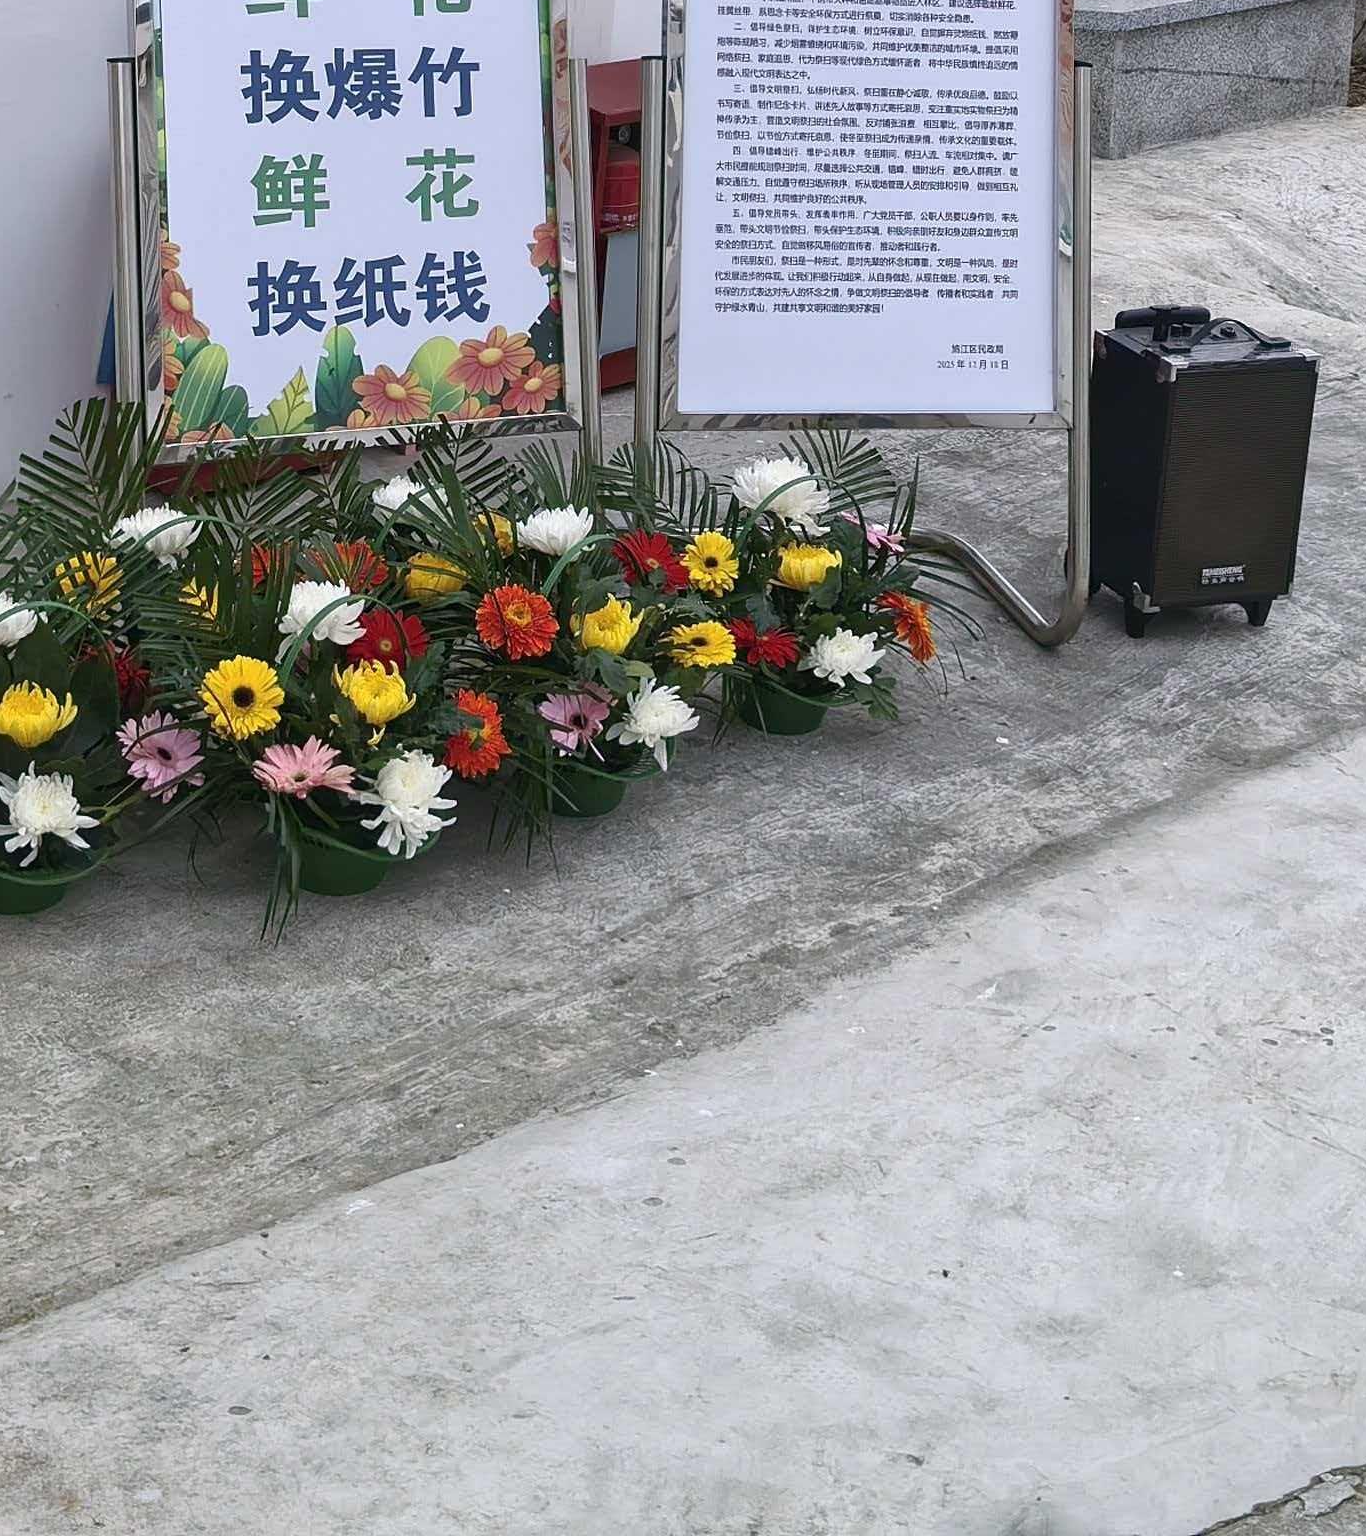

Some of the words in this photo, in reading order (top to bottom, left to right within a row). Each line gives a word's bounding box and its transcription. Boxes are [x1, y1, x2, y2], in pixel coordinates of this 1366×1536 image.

[240, 46, 481, 124] 换爆竹
[247, 249, 491, 337] 换纸钱
